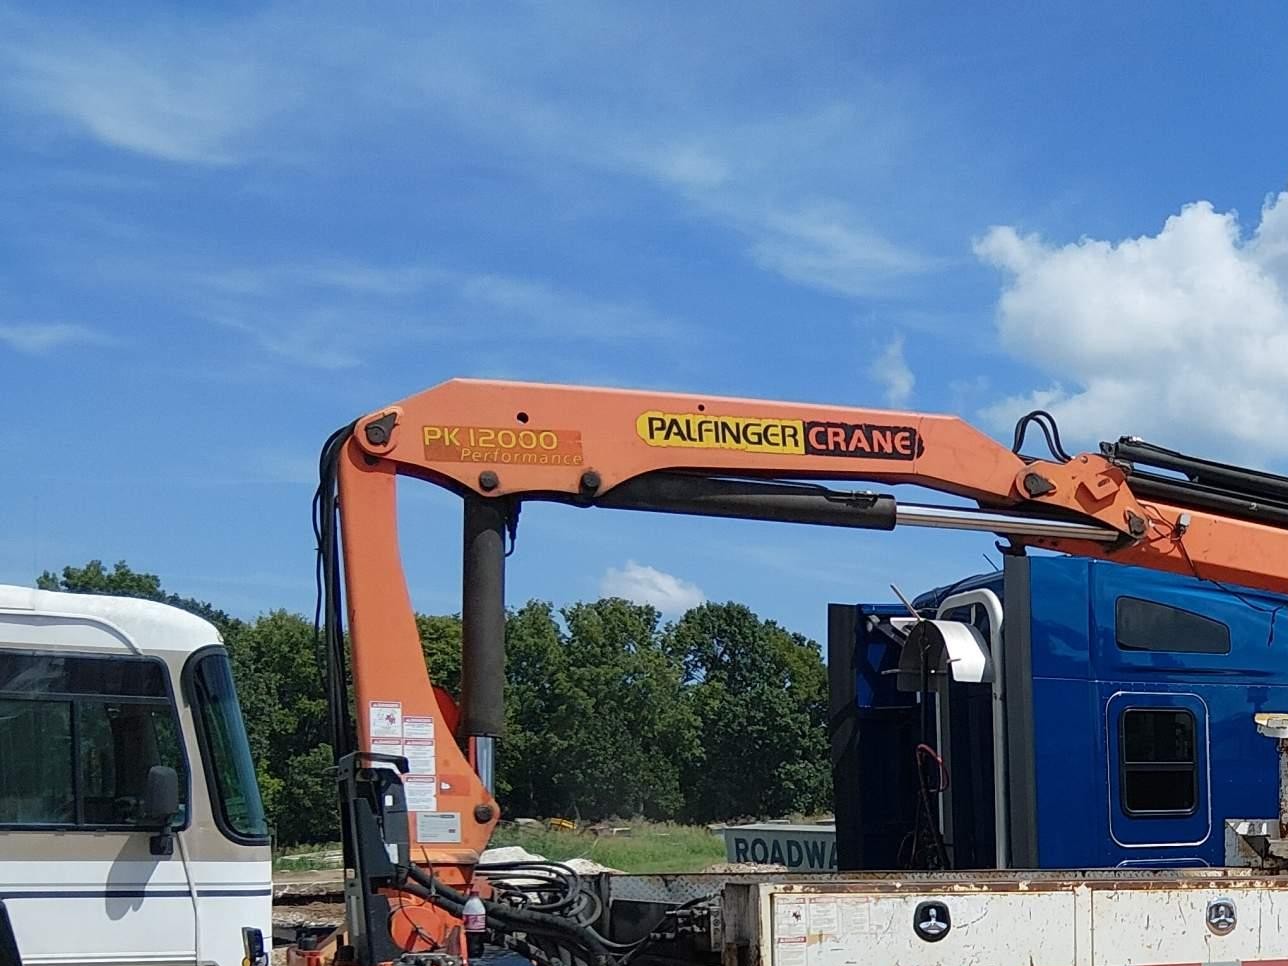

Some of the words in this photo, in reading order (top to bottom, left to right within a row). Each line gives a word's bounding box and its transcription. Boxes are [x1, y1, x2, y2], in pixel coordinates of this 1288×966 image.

[423, 426, 460, 446] PK
[469, 430, 558, 450] 12000
[647, 416, 800, 448] PALFINGER
[808, 426, 912, 455] CRANE
[461, 448, 583, 465] Performance
